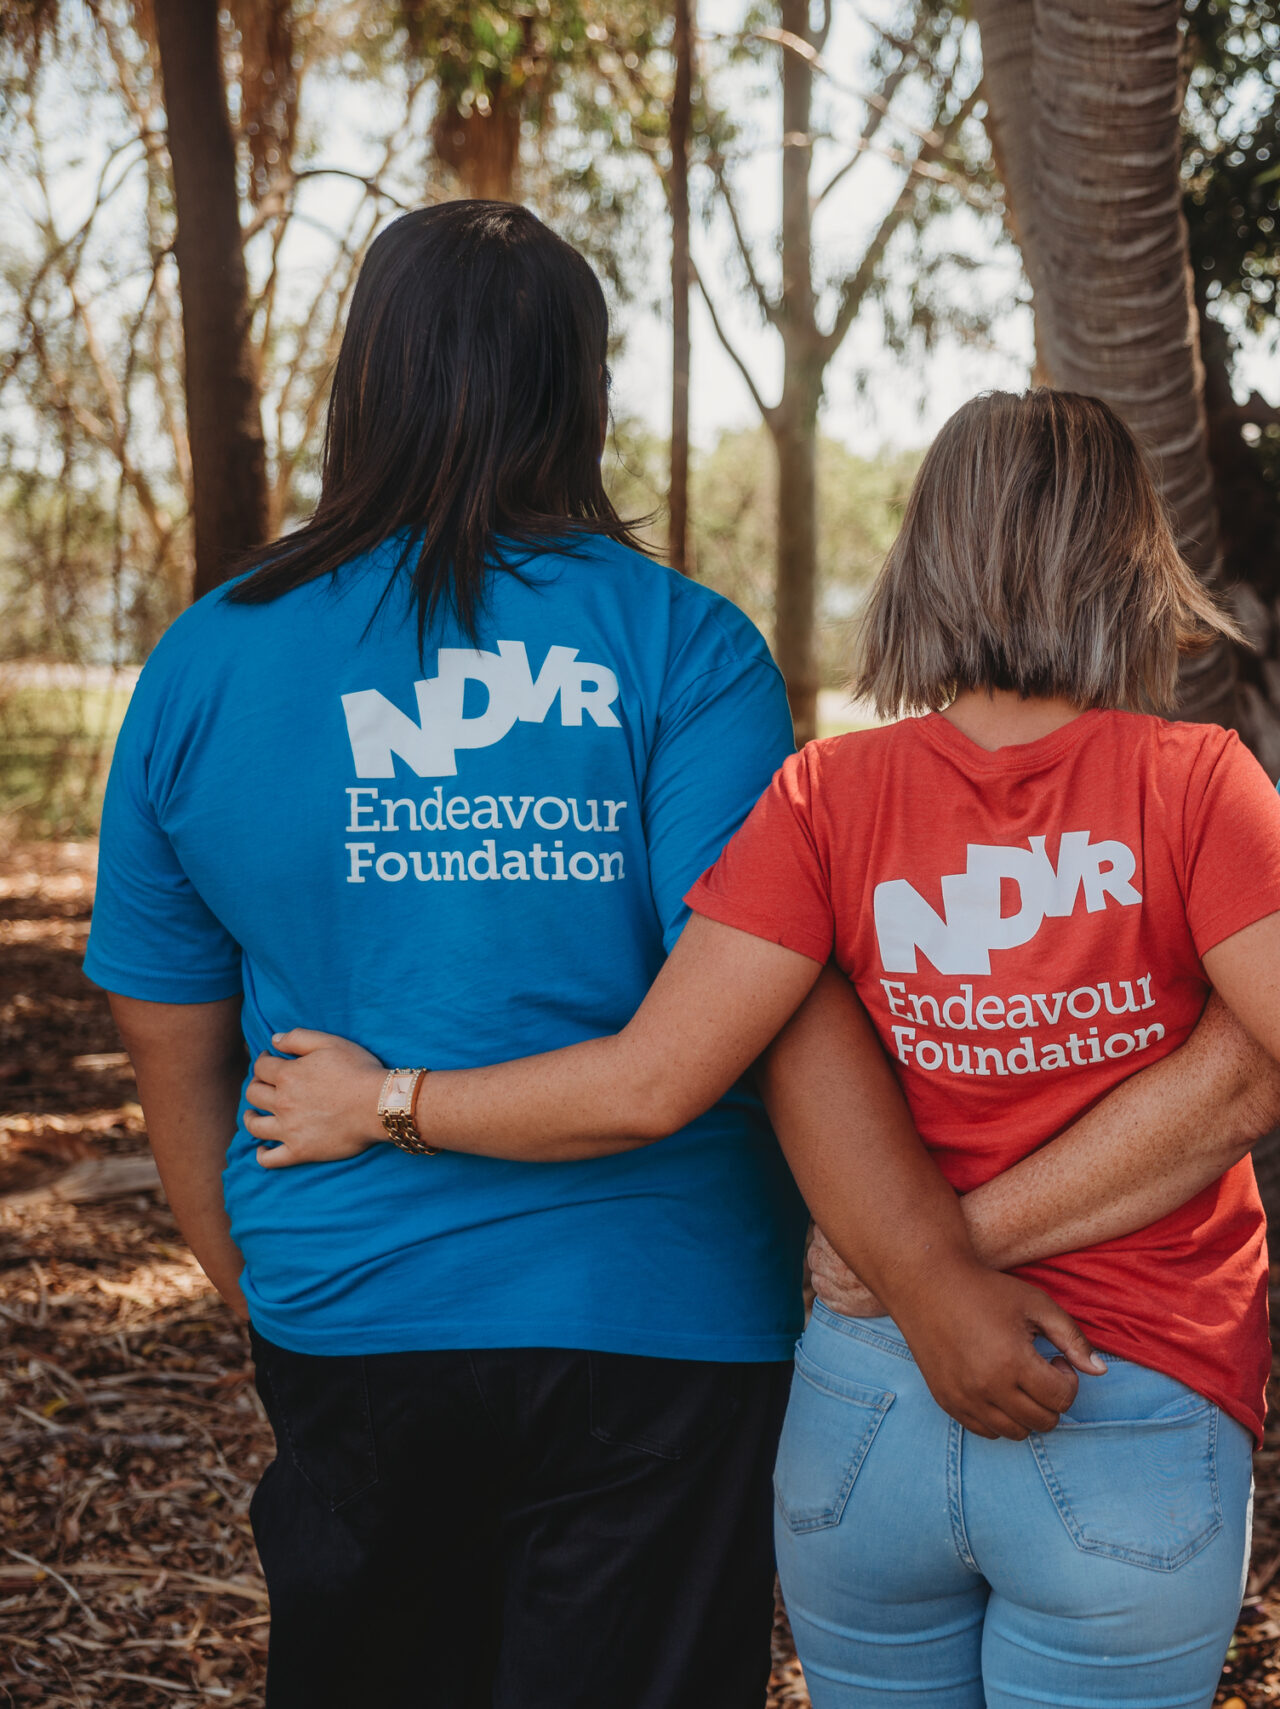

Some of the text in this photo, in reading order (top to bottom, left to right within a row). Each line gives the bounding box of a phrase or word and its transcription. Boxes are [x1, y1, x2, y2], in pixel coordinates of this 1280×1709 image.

[341, 640, 622, 778] NDVR
[345, 786, 627, 832] Endeavour
[345, 840, 625, 883] Foundation
[874, 830, 1142, 975] NDVR
[880, 972, 1156, 1031] Endeavour
[891, 1022, 1166, 1076] Foundation
